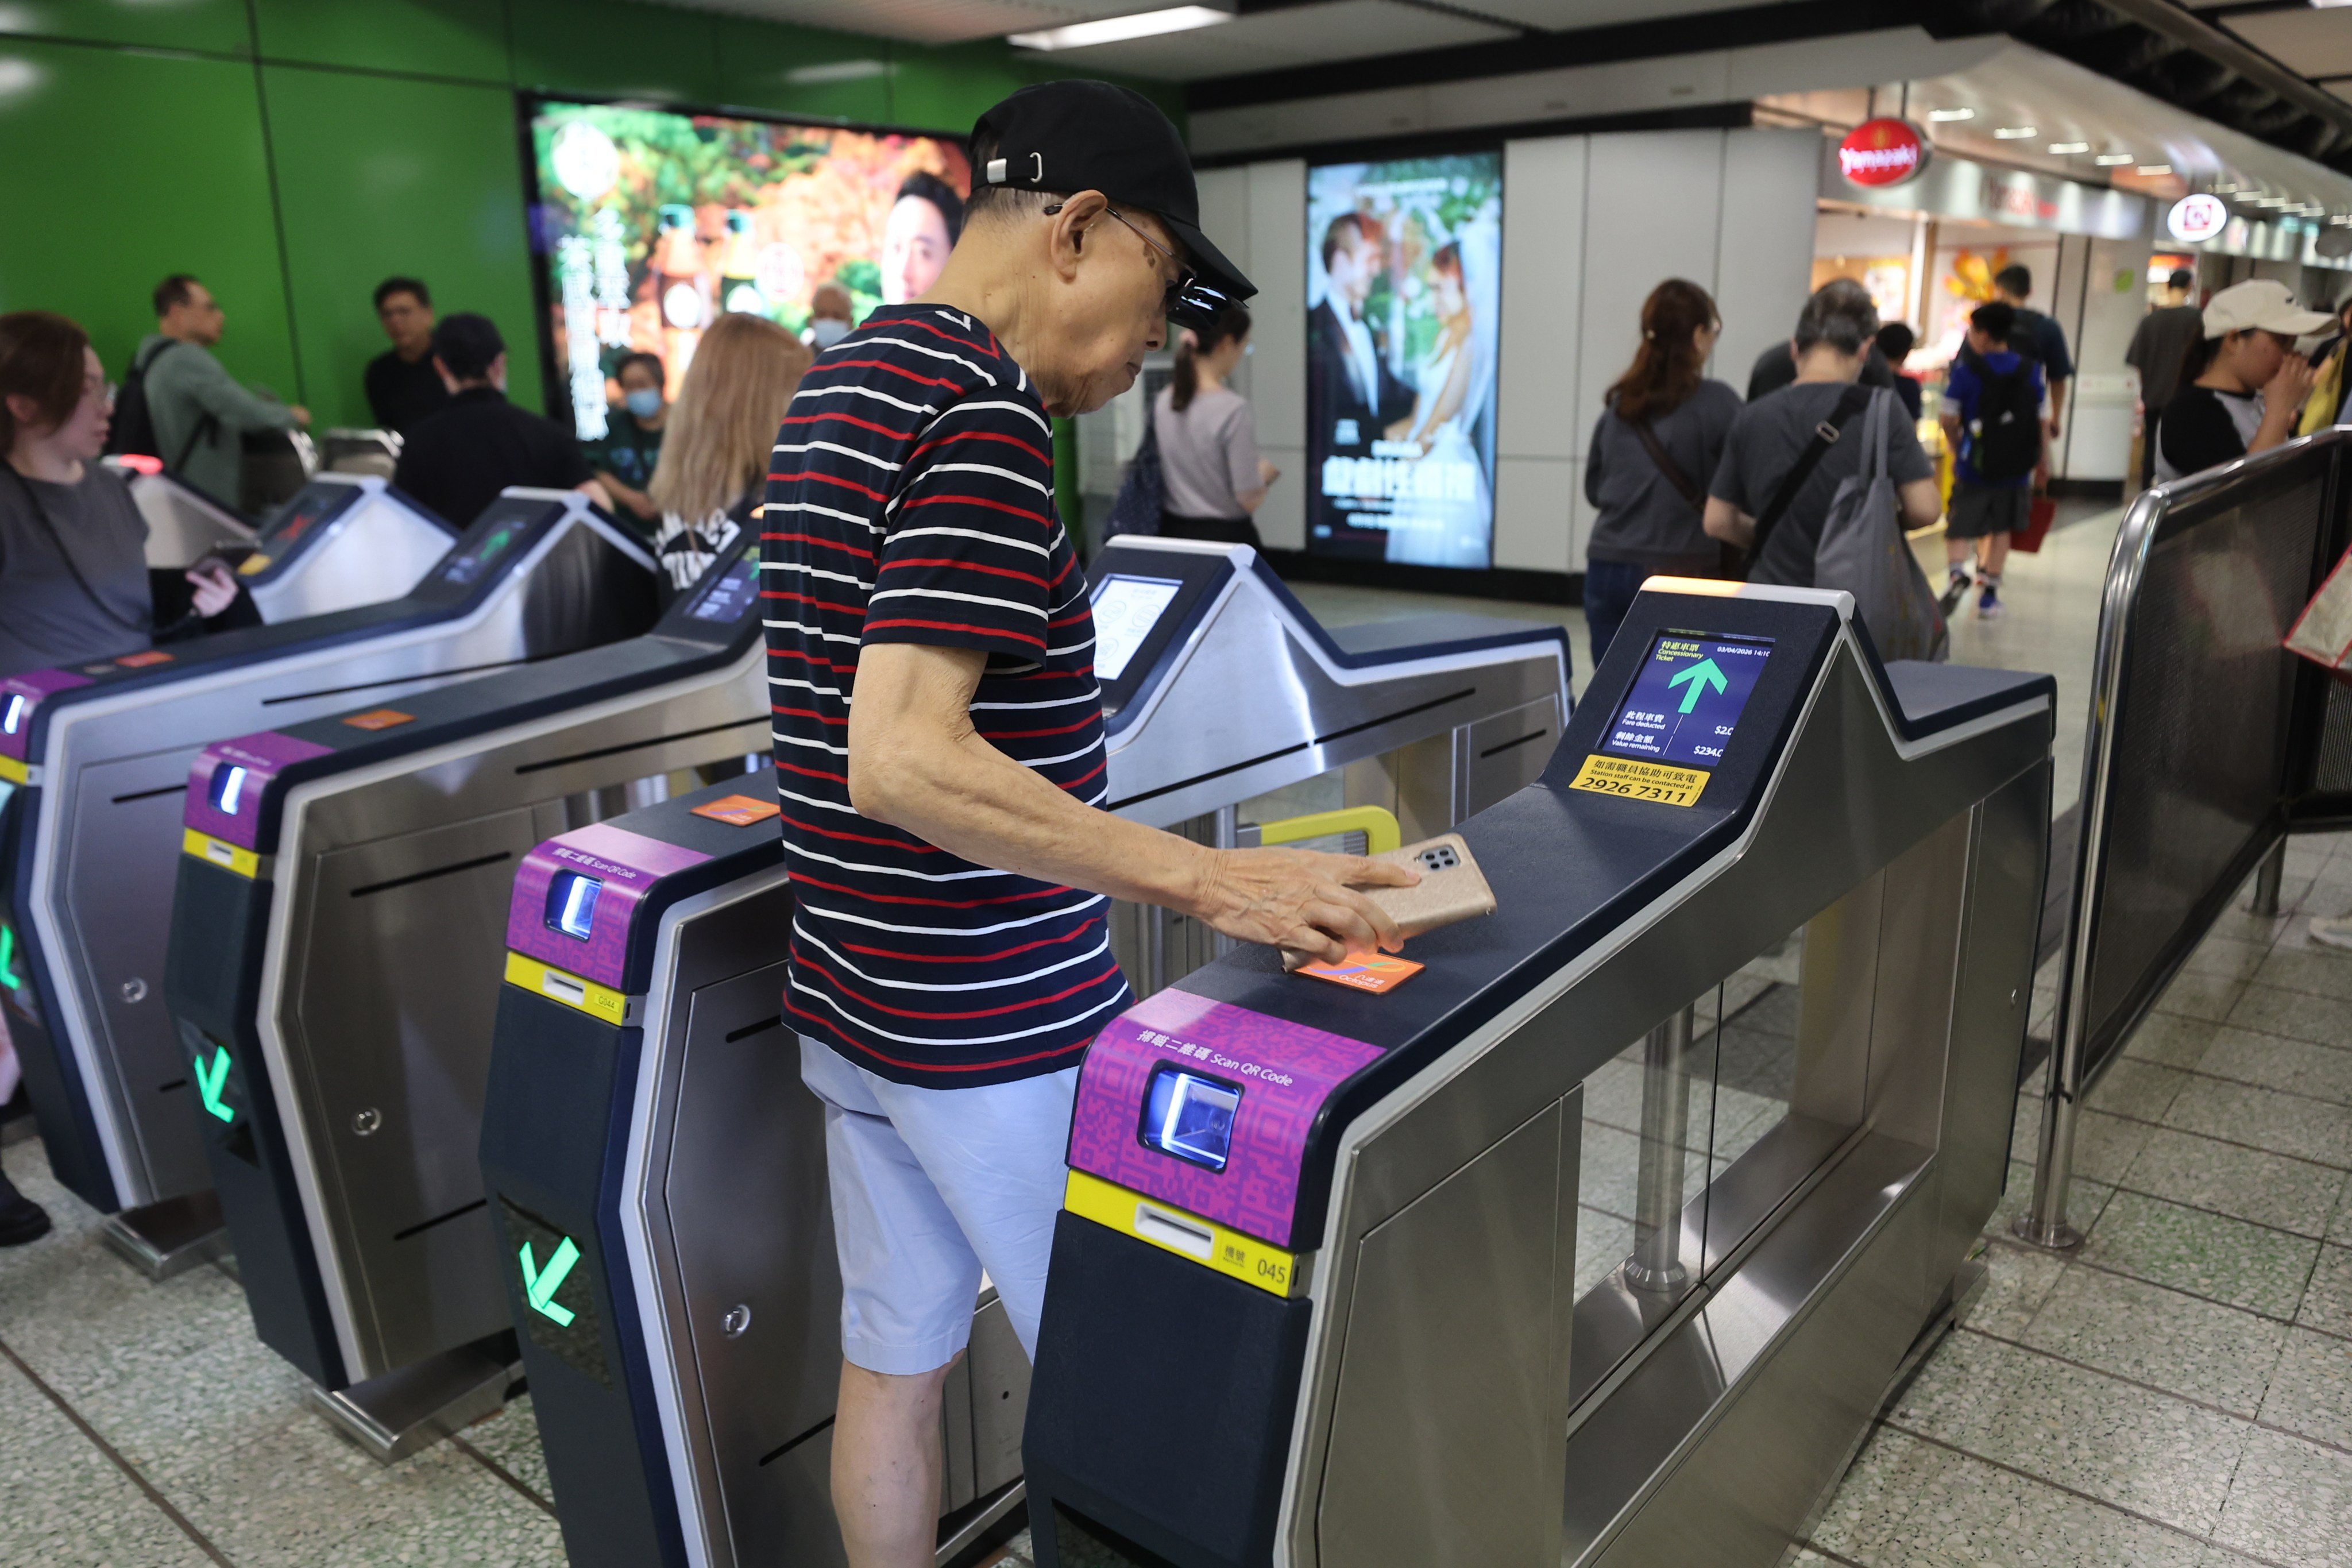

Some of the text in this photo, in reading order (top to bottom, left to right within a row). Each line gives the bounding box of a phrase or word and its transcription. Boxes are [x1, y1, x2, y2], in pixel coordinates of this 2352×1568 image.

[1839, 144, 1918, 175] Yamazaki
[1658, 648, 1704, 659] Concessionary
[1717, 646, 1752, 656] 03/04/2026
[1635, 720, 1666, 730] deducted
[1612, 739, 1660, 753] Value remaining
[1590, 769, 1613, 777] Station
[1651, 779, 1686, 789] contacted
[1594, 760, 1697, 783] 如需職員協助可致電
[1579, 777, 1632, 794] 2926
[1635, 786, 1686, 803] 7311
[592, 861, 609, 870] Scan
[617, 869, 636, 879] Code
[1338, 975, 1378, 988] Octopus
[598, 996, 615, 1009] G044
[1136, 1029, 1293, 1087] 掃瞄二維碼 Scan QR Code
[1258, 1258, 1286, 1284] 045
